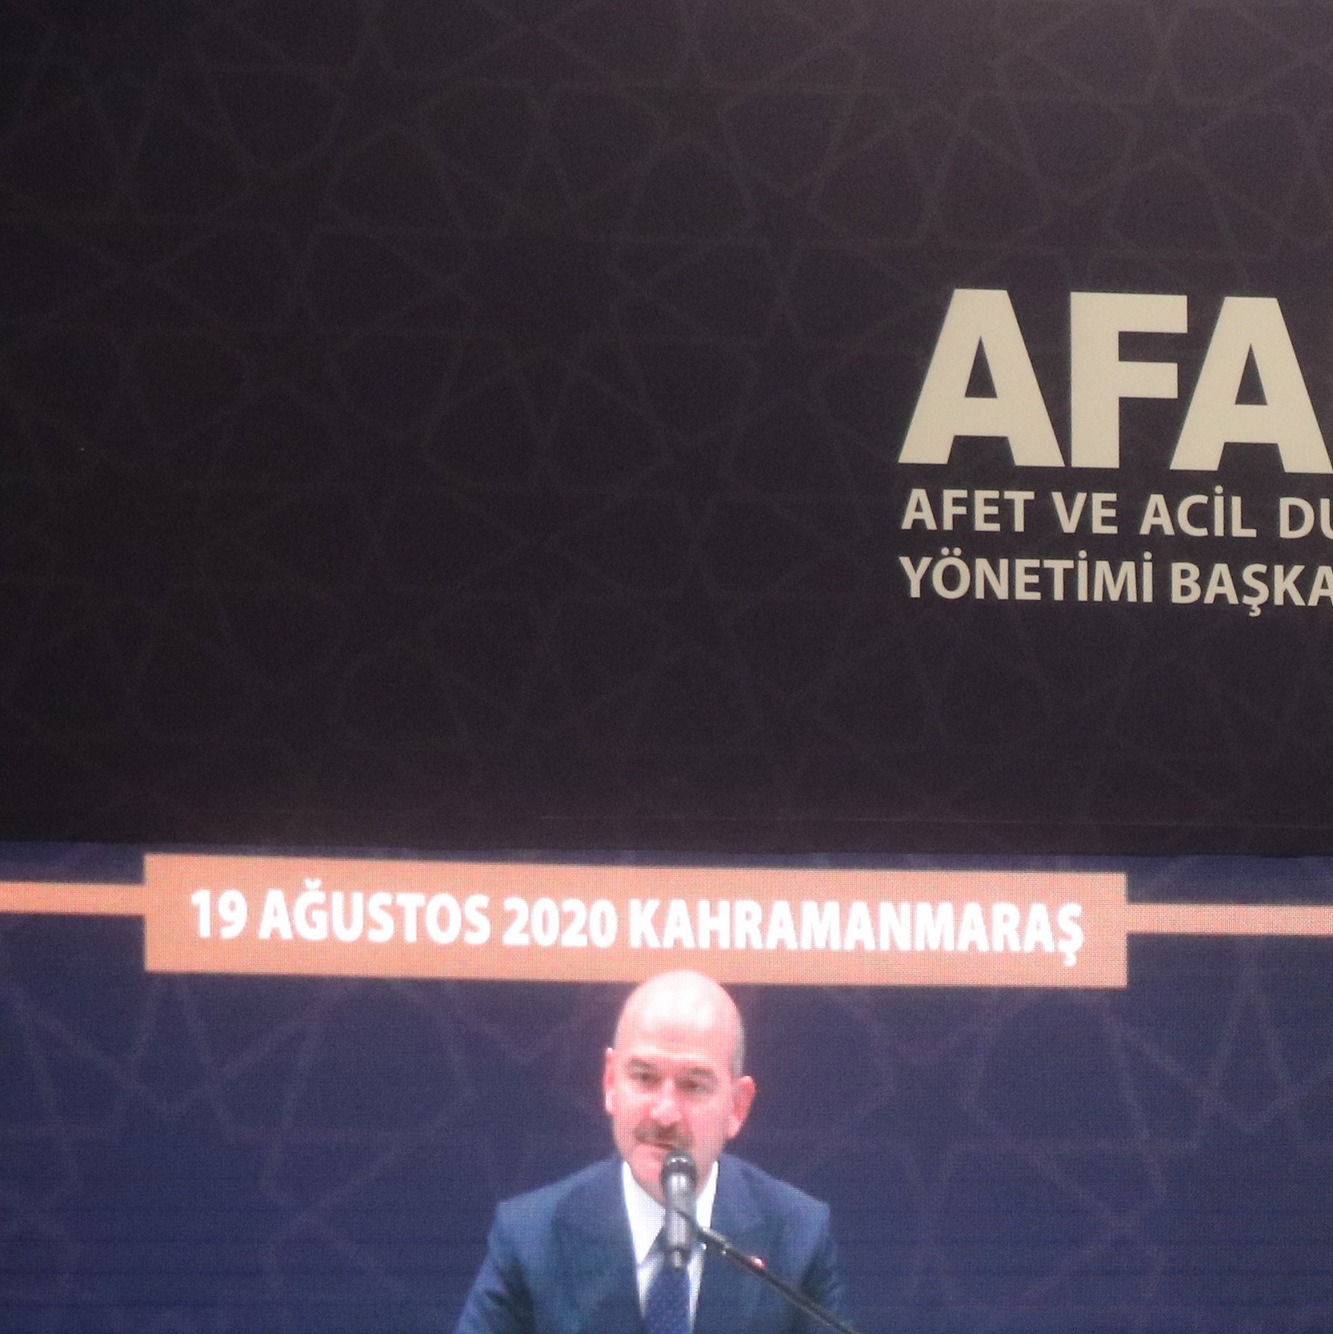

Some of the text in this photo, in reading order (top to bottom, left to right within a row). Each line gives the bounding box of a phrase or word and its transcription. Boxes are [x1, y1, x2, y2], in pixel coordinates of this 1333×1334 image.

[902, 490, 1034, 532] AFET
[1052, 493, 1118, 535] VE
[1140, 485, 1256, 537] ACİL
[899, 547, 1152, 602] YÖNETİMİ
[190, 879, 1084, 966] 19 AĞUSTOS 2020 KAHRAMANMARAŞ
